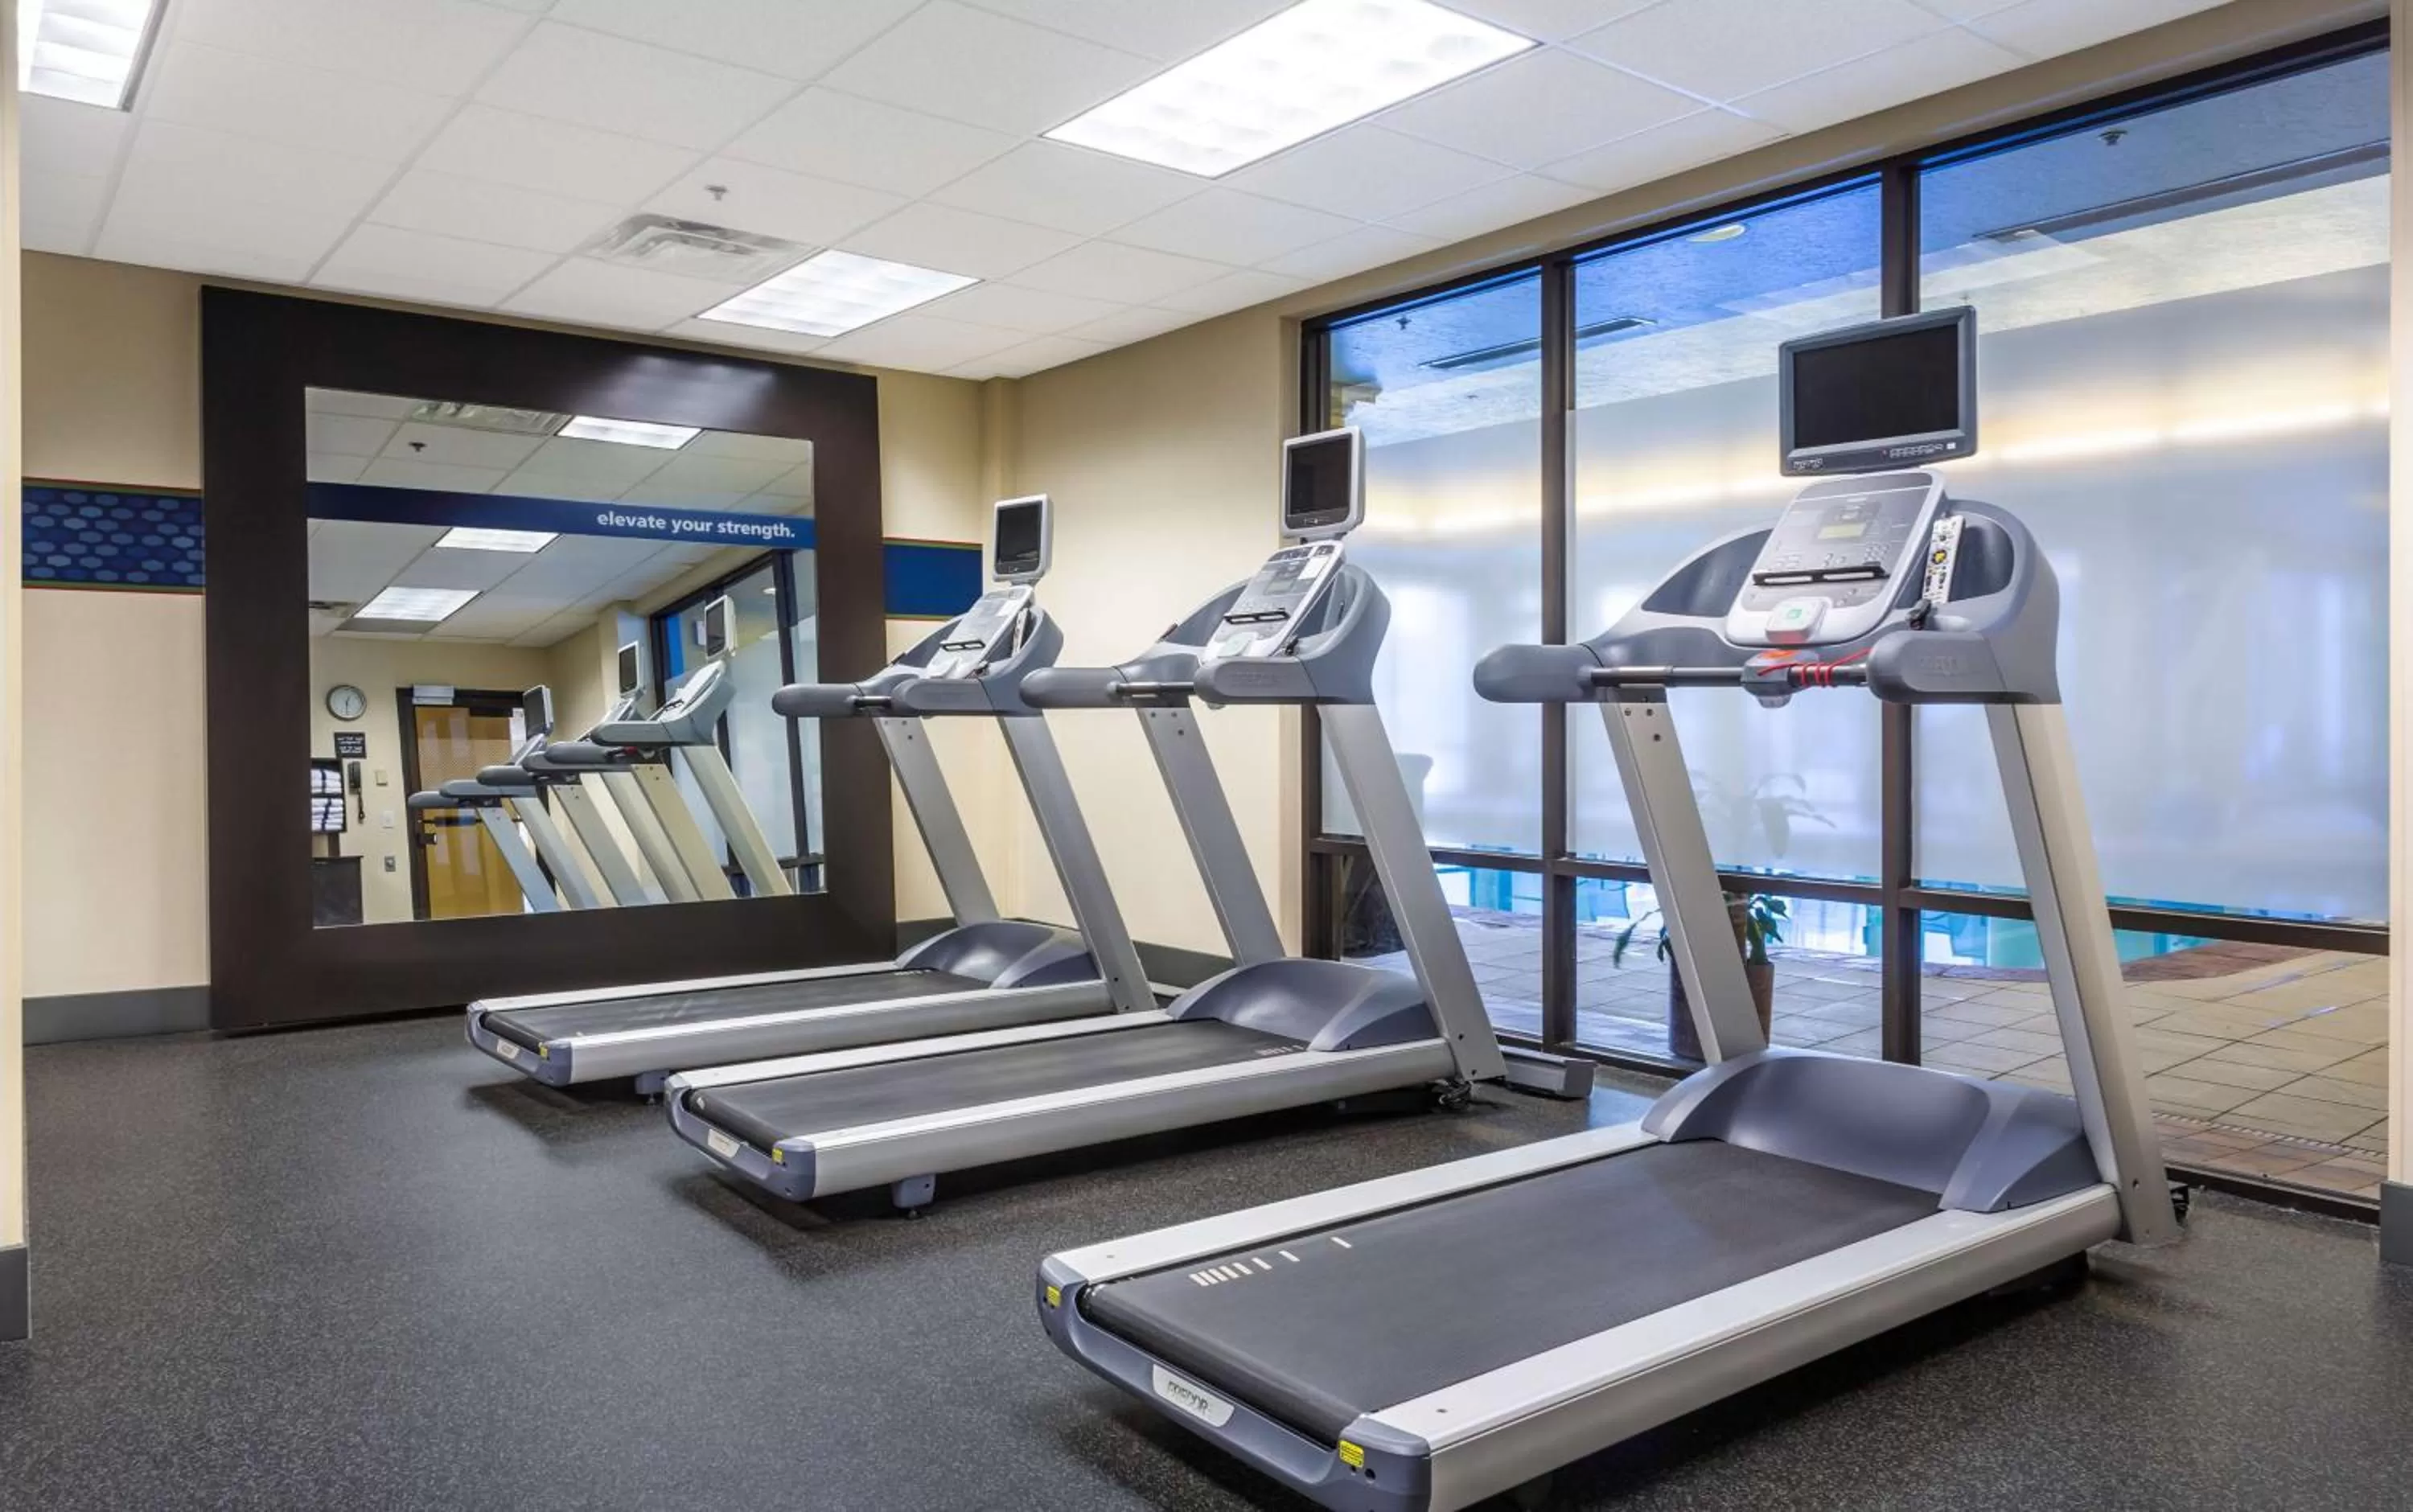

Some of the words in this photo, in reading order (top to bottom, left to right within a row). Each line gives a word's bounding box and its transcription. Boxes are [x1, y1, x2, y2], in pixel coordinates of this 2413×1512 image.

[597, 511, 667, 530] elevate
[671, 518, 713, 534] your
[717, 521, 795, 540] strength.
